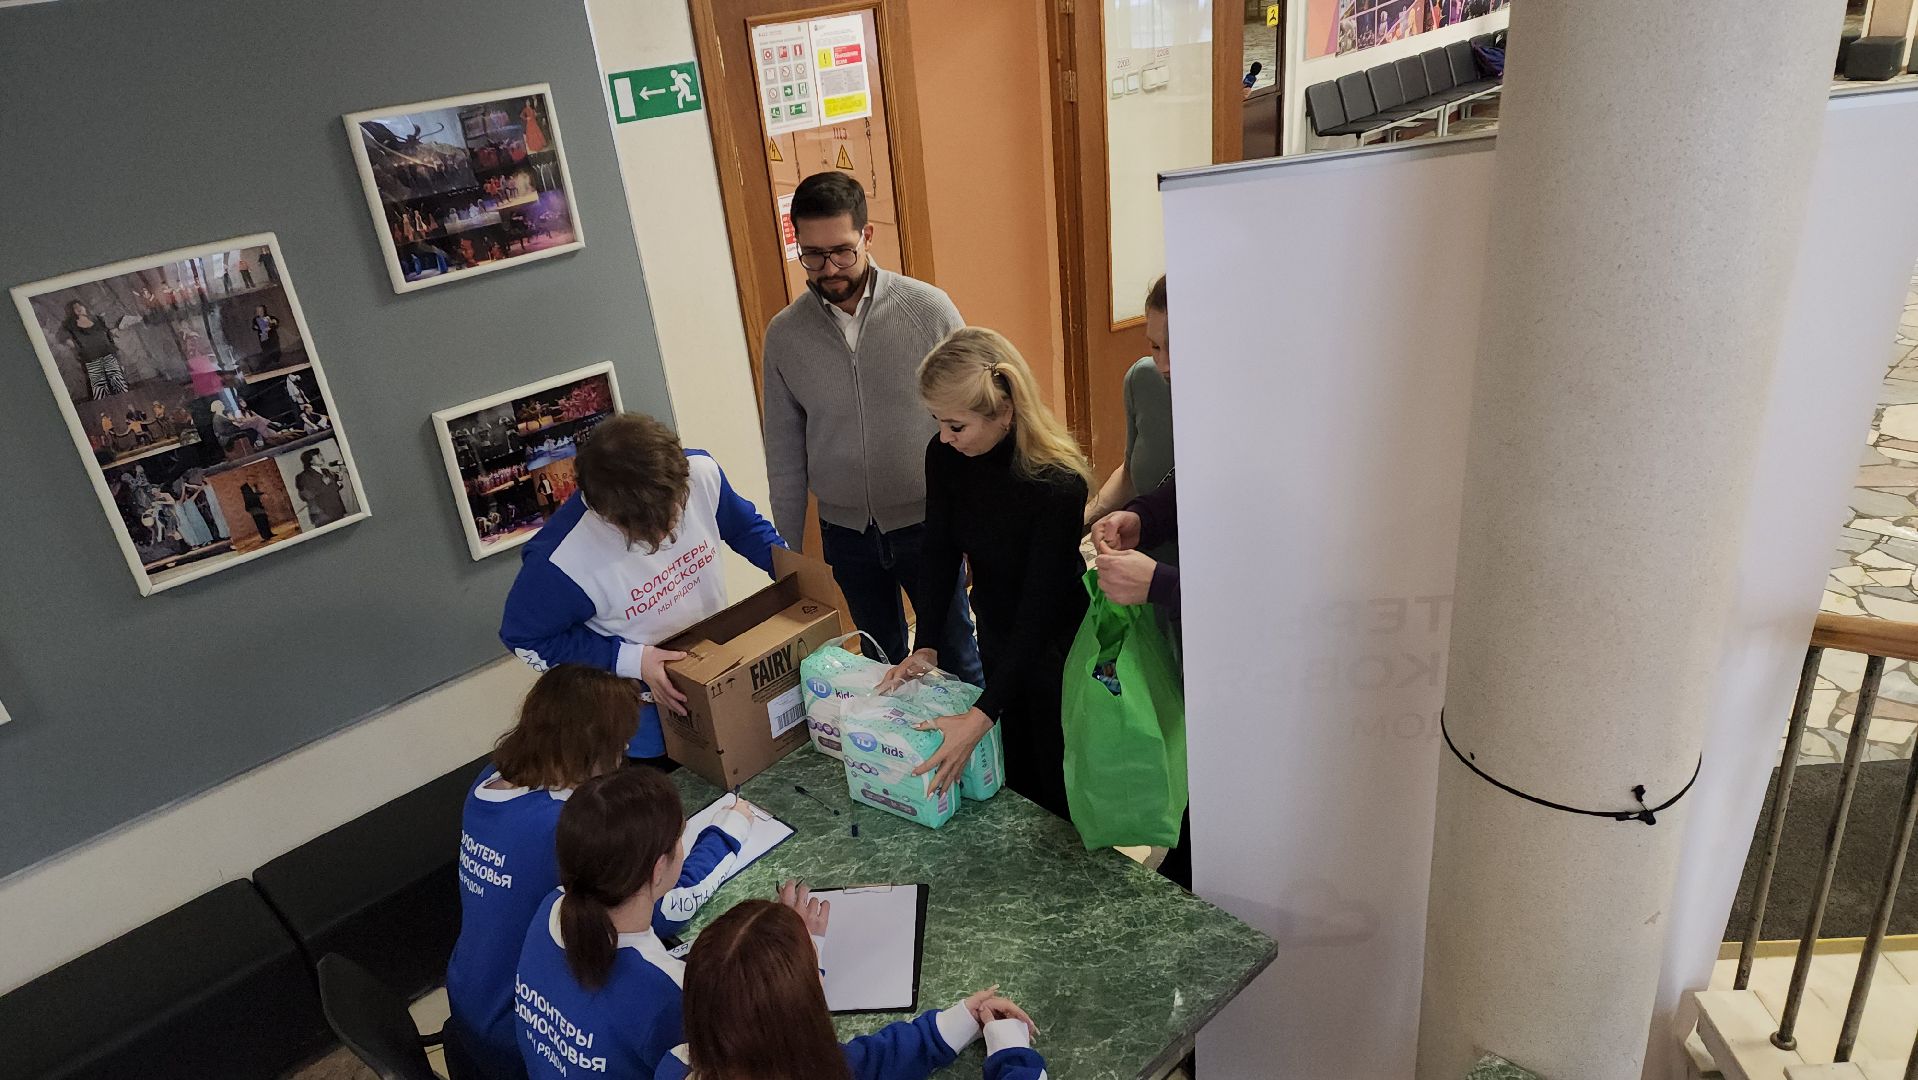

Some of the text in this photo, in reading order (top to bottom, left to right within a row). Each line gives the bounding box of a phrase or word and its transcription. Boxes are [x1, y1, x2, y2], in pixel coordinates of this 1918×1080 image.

[624, 547, 717, 621] ПОДМОСКОВЬЯ
[630, 539, 709, 602] ВОЛОНТЕРЫ
[657, 576, 701, 615] МЫ РЯДОМ
[749, 644, 793, 691] FAIRY
[813, 680, 827, 694] iD
[880, 744, 905, 759] kids
